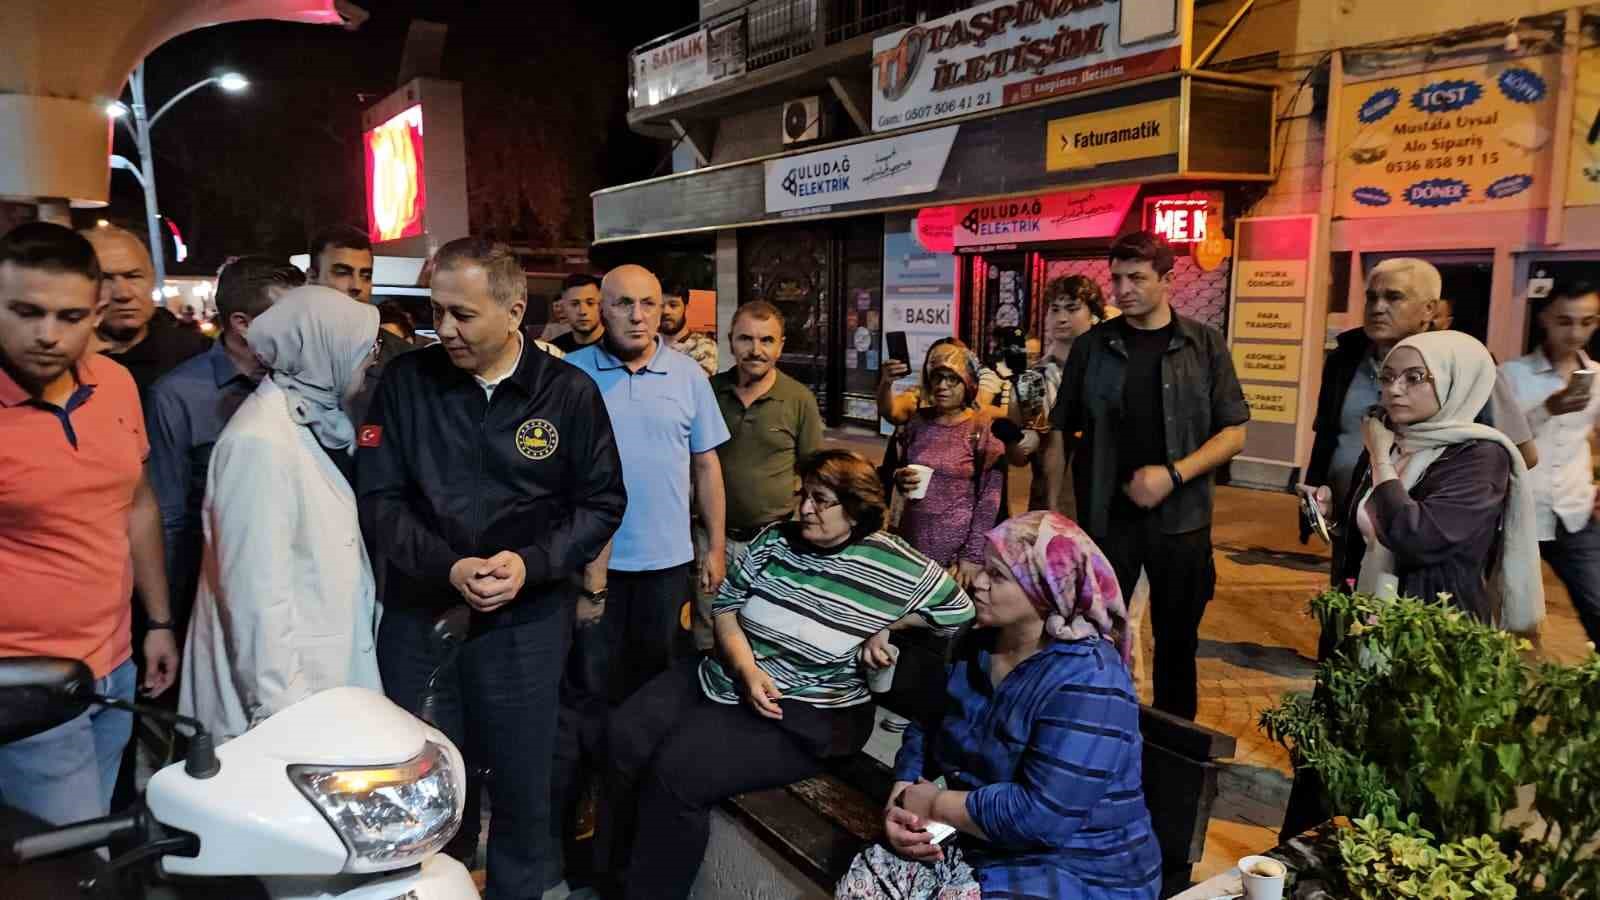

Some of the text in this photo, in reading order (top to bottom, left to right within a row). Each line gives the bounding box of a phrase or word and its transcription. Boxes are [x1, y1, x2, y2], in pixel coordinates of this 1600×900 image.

[905, 105, 932, 120] 0507
[934, 100, 956, 115] 506
[958, 96, 973, 109] 41
[976, 92, 992, 106] 21
[1074, 120, 1160, 148] Faturamatik
[1393, 119, 1451, 134] Mustafa
[1403, 133, 1483, 152] Alo Sipariş
[797, 153, 850, 180] ULUDAĞ
[1385, 151, 1499, 173] 0536 858 91 15
[1411, 183, 1464, 200] DÖNER
[906, 303, 950, 325] BASKİ
